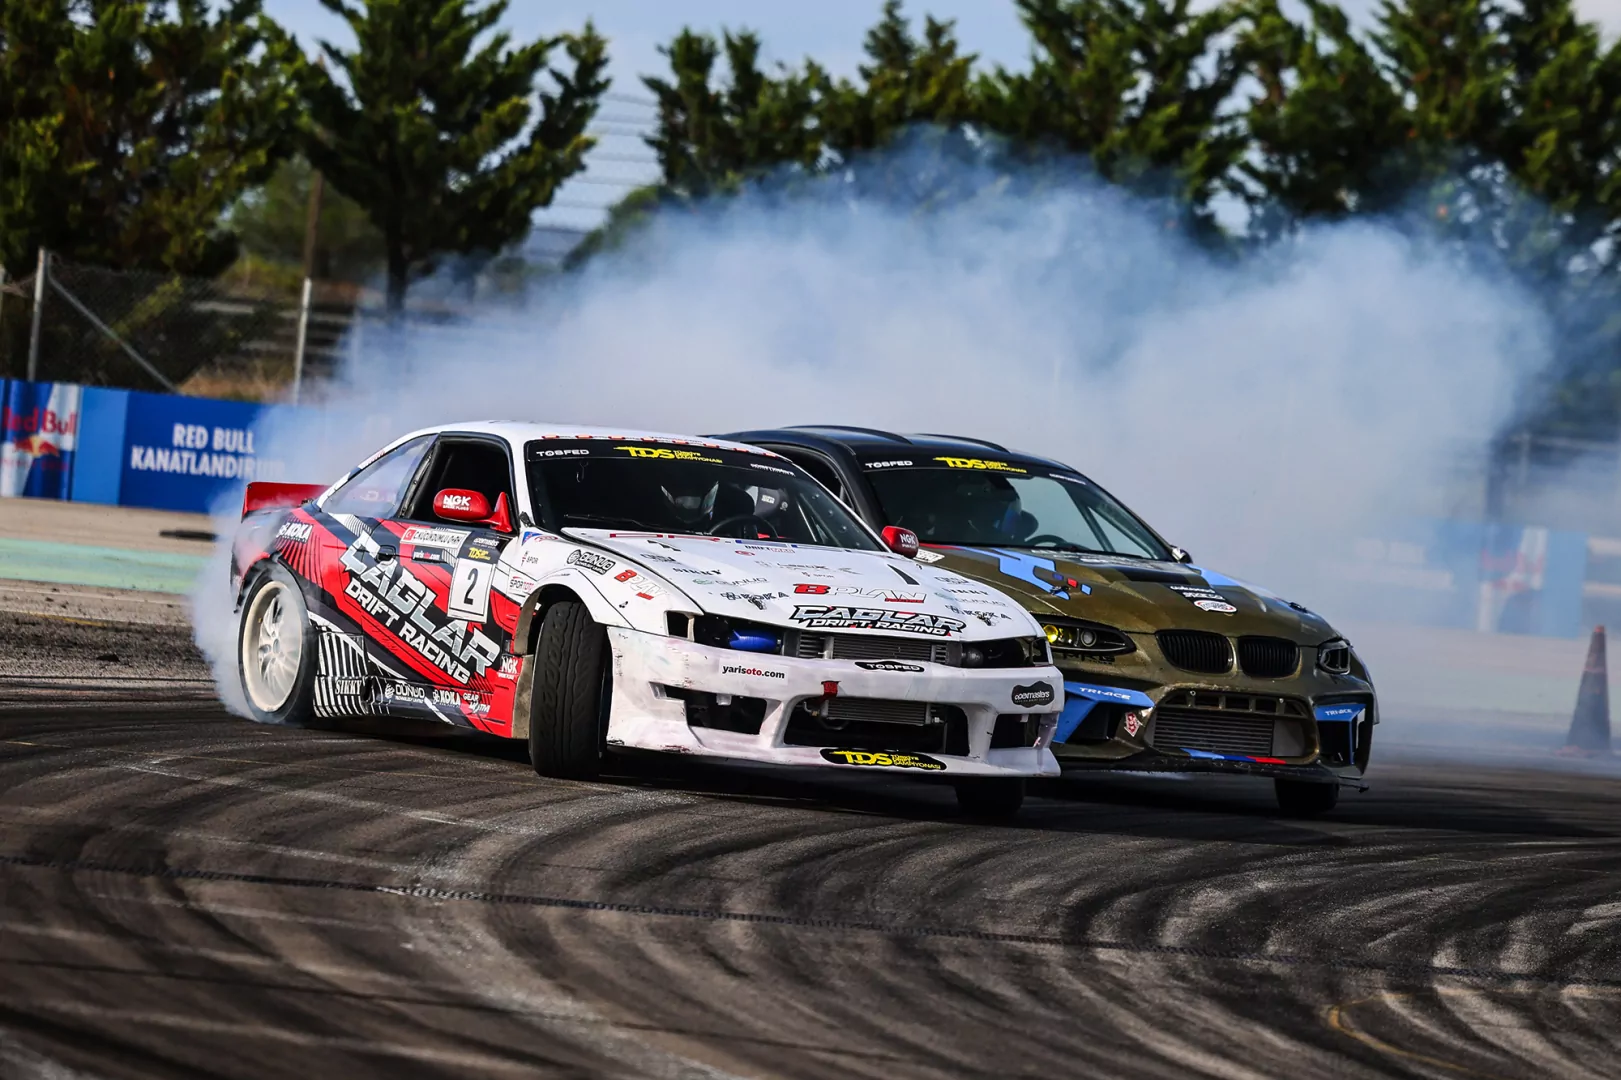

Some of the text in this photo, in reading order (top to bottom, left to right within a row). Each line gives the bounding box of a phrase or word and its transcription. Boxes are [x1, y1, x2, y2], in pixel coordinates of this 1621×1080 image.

[172, 423, 255, 454] RED BULL
[536, 449, 590, 457] TOSFED
[614, 446, 675, 460] TDS
[865, 460, 913, 469] TOSFED
[933, 457, 987, 469] TDS
[443, 494, 471, 507] NGK
[900, 533, 916, 545] NGK
[463, 567, 479, 606] 2
[793, 583, 927, 603] BPLAN
[345, 577, 471, 684] DRIFT RACING
[811, 618, 947, 635] DRIFT RACING
[501, 656, 518, 675] NGK
[722, 665, 785, 679] yarisoto.com
[867, 663, 920, 672] TOSFED
[440, 690, 461, 706] KOKA
[463, 692, 479, 701] GEAR
[830, 750, 893, 765] TDS
